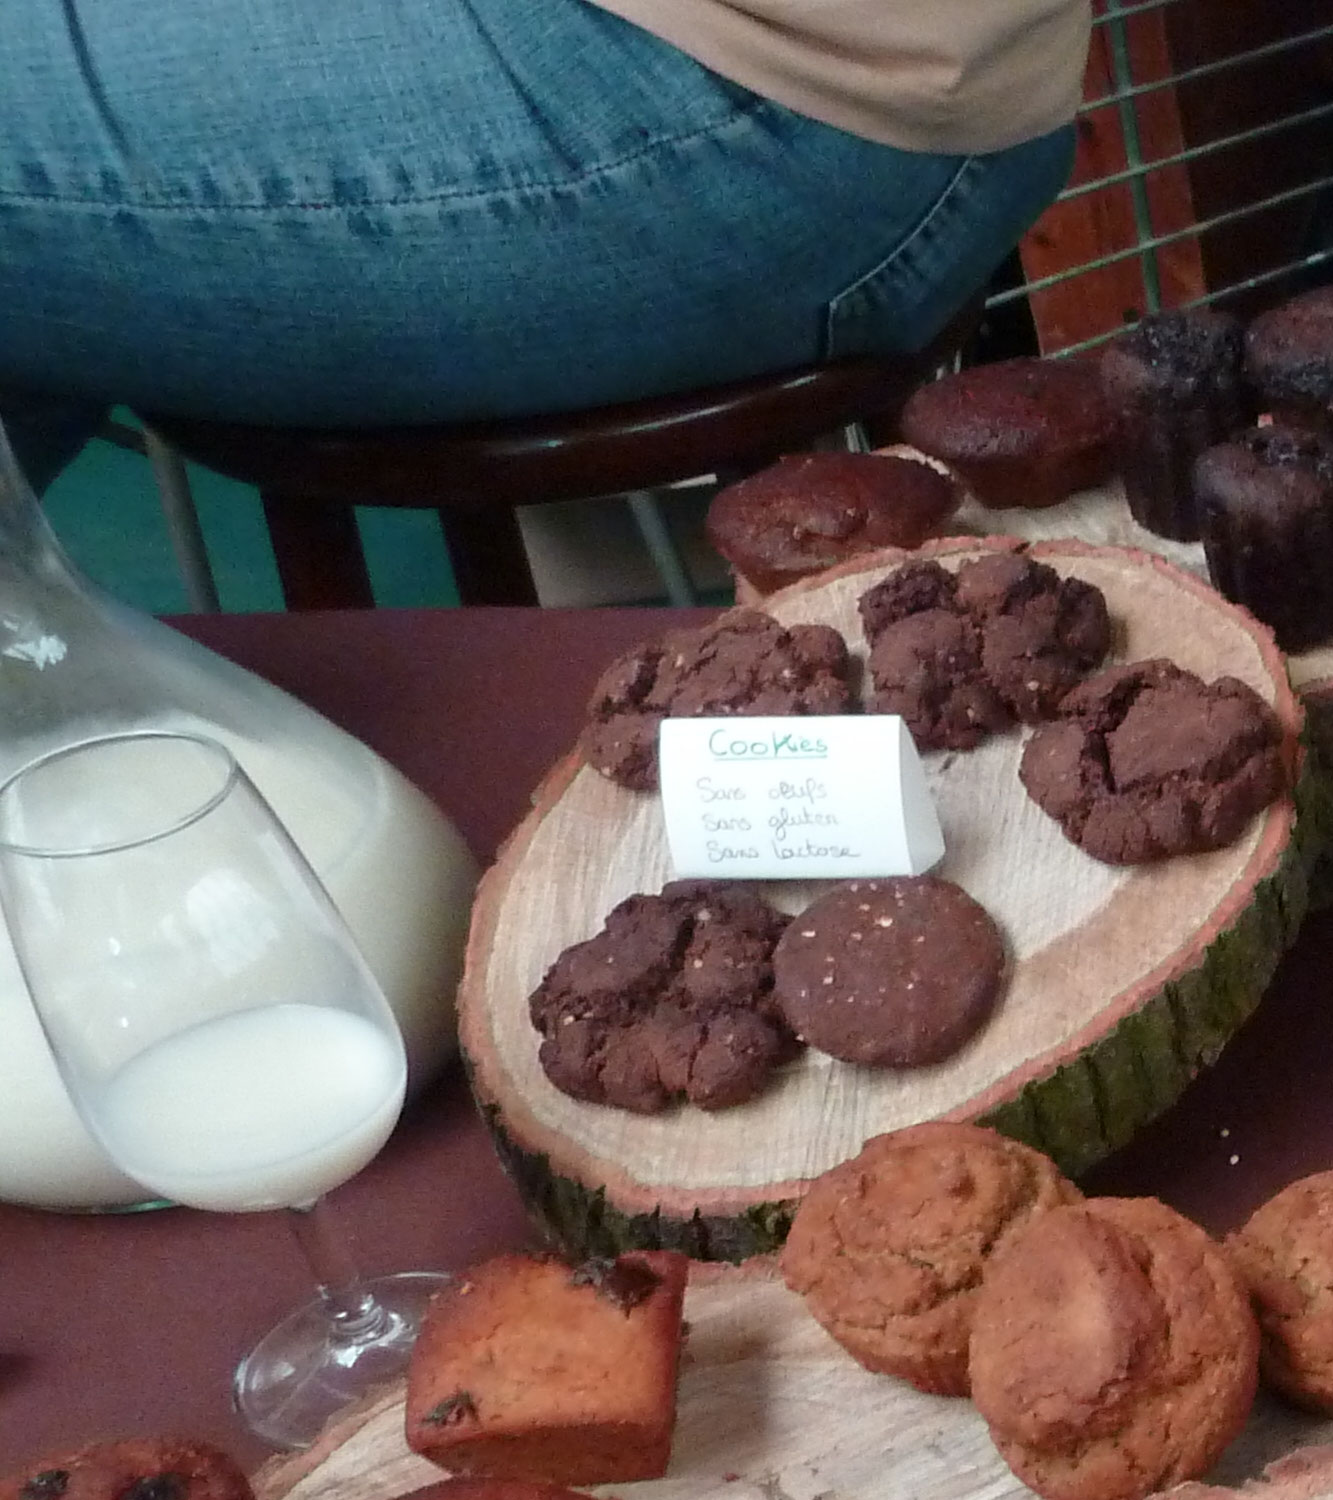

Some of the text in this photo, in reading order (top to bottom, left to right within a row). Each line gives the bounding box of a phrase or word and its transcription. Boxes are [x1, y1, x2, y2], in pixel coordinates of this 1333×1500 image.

[709, 729, 828, 757] Cookies
[696, 776, 746, 803] Sans
[768, 807, 838, 841] gluten
[706, 839, 861, 863] Sans lactose
